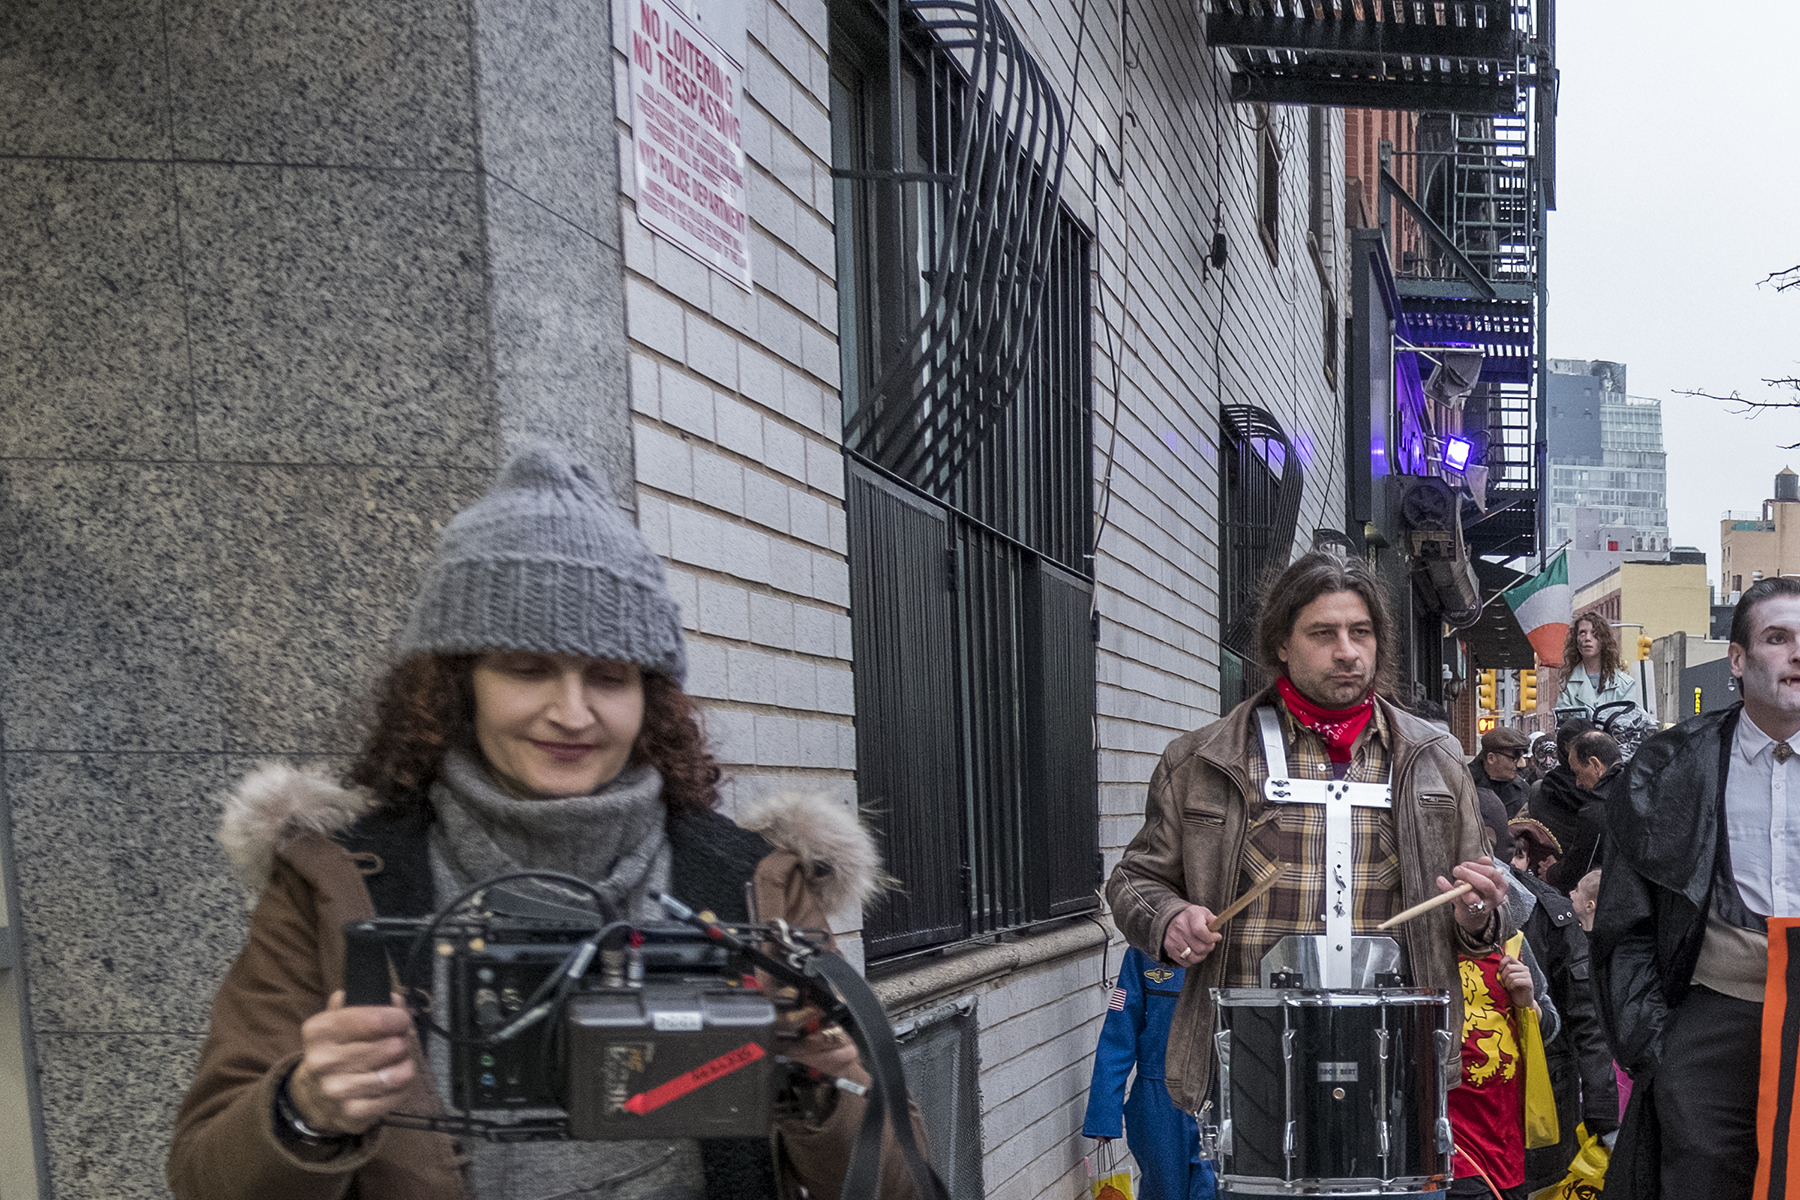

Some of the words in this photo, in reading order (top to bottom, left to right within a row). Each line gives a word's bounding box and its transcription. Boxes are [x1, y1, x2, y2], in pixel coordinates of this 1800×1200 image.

[633, 30, 652, 75] NO
[656, 50, 741, 151] TRESPASSING
[641, 0, 660, 44] NO
[665, 20, 732, 109] LOITERING
[639, 138, 656, 173] NYC
[659, 153, 689, 197] POLICE
[692, 178, 744, 236] DEPARTMENT
